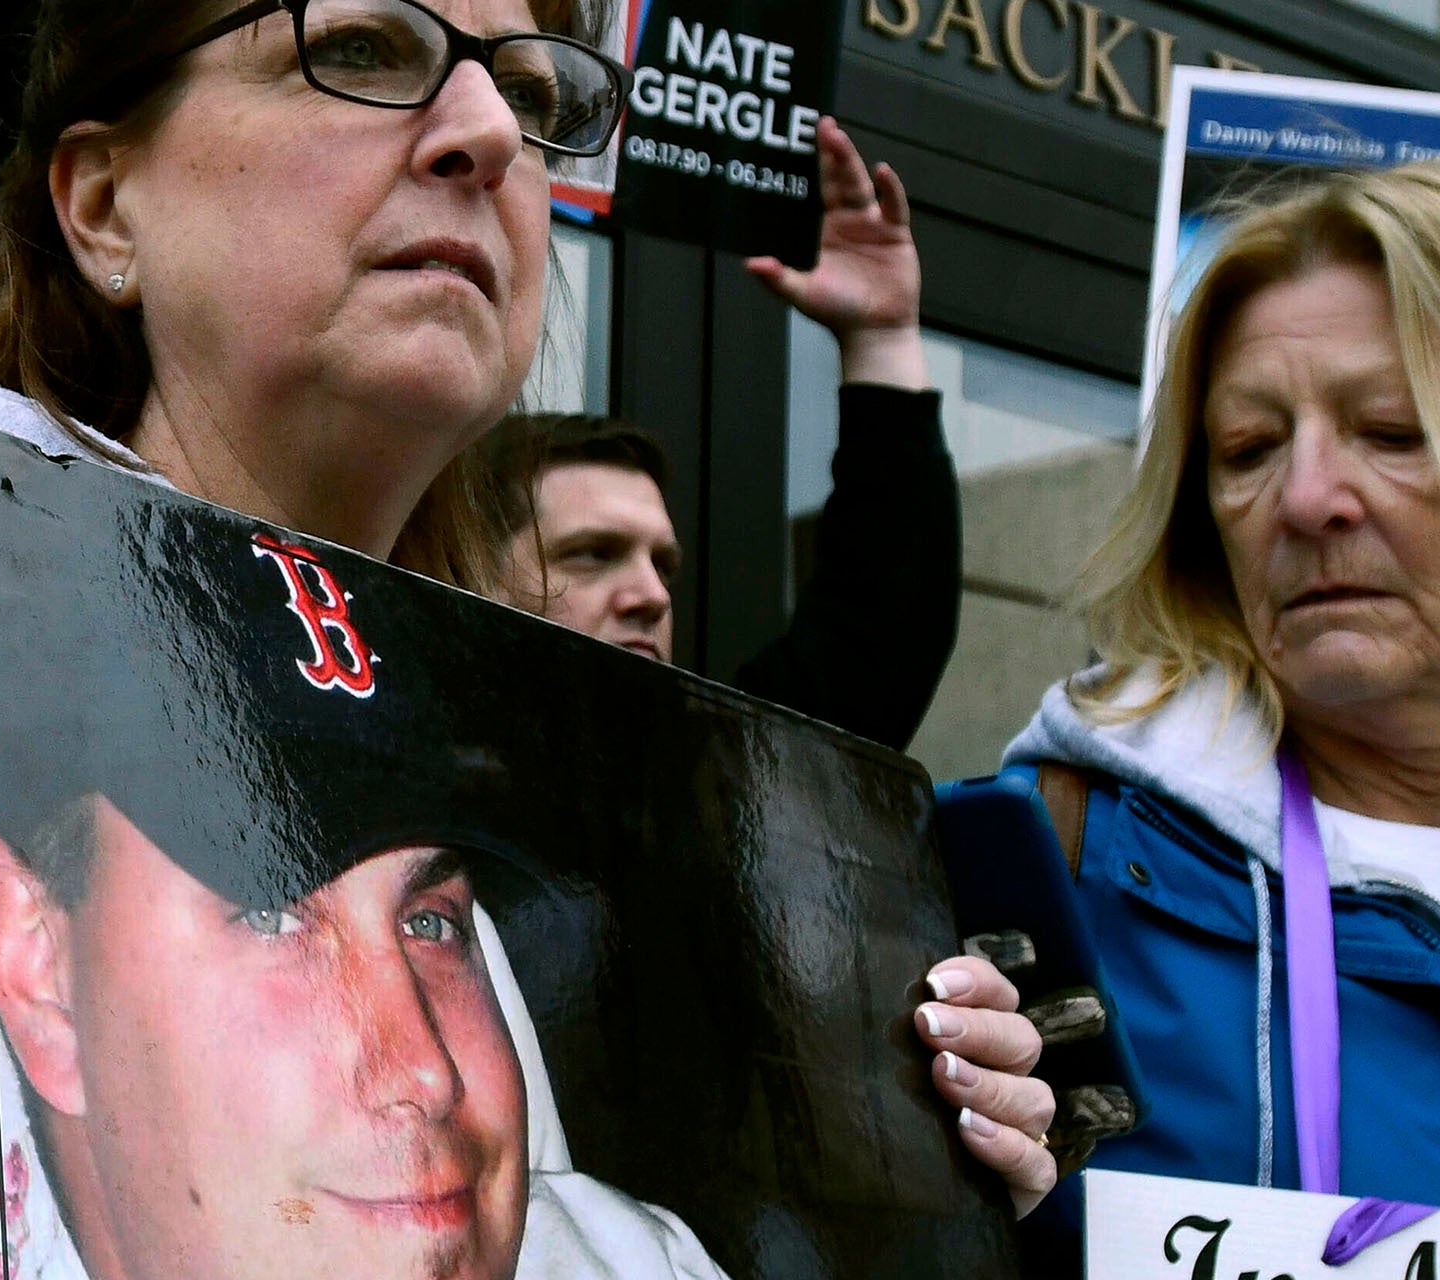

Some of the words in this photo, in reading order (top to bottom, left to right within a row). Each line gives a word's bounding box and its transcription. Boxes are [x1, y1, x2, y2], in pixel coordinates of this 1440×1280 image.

[665, 16, 795, 95] NATE
[627, 66, 820, 156] GERGLE
[1201, 118, 1275, 154] Danny
